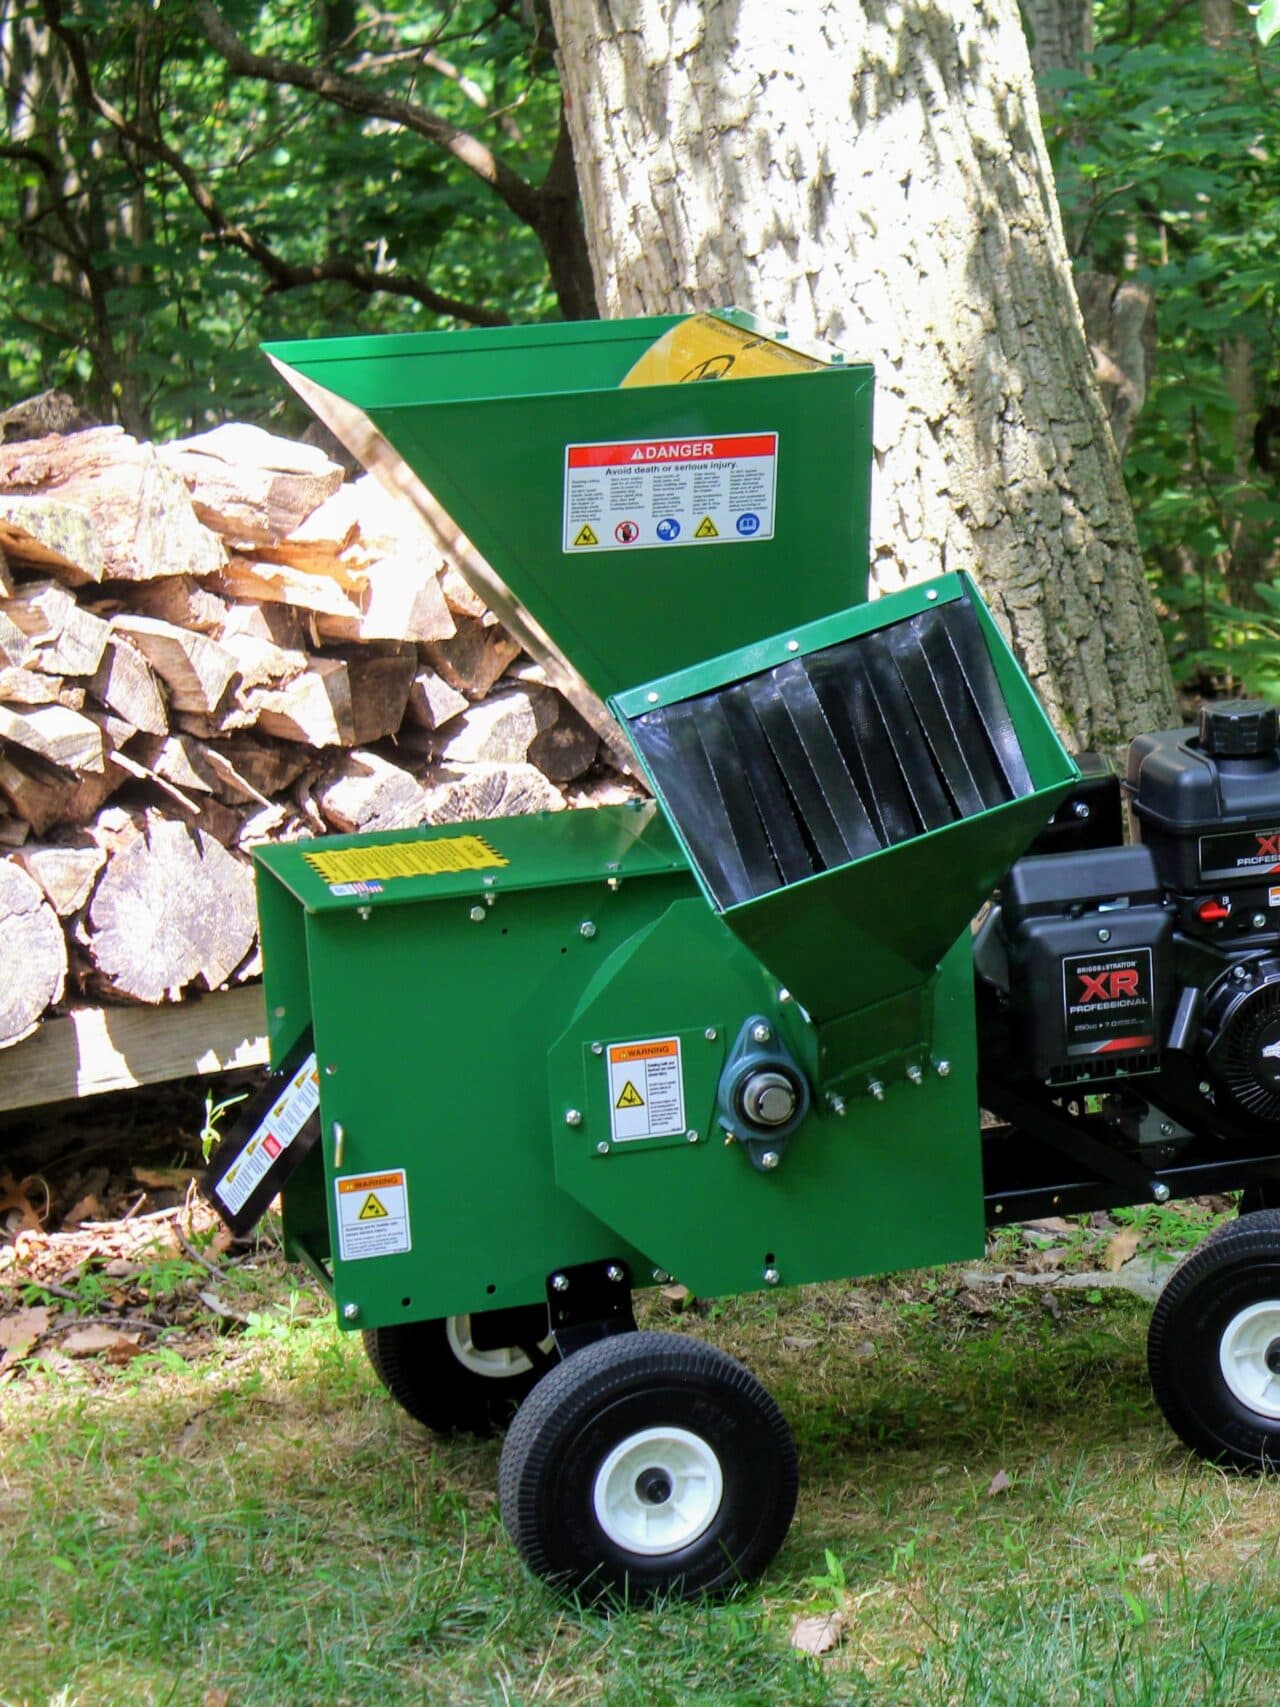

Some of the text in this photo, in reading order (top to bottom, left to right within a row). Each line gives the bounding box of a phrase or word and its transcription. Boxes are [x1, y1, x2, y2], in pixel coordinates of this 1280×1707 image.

[646, 443, 714, 459] DANGER
[605, 467, 632, 476] Avoid
[634, 465, 660, 475] death
[674, 462, 708, 472] serious
[1078, 969, 1139, 1003] XR
[1069, 997, 1148, 1014] PROFESSIONAL
[627, 1045, 670, 1057] WARNING
[355, 1176, 398, 1188] WARNING
